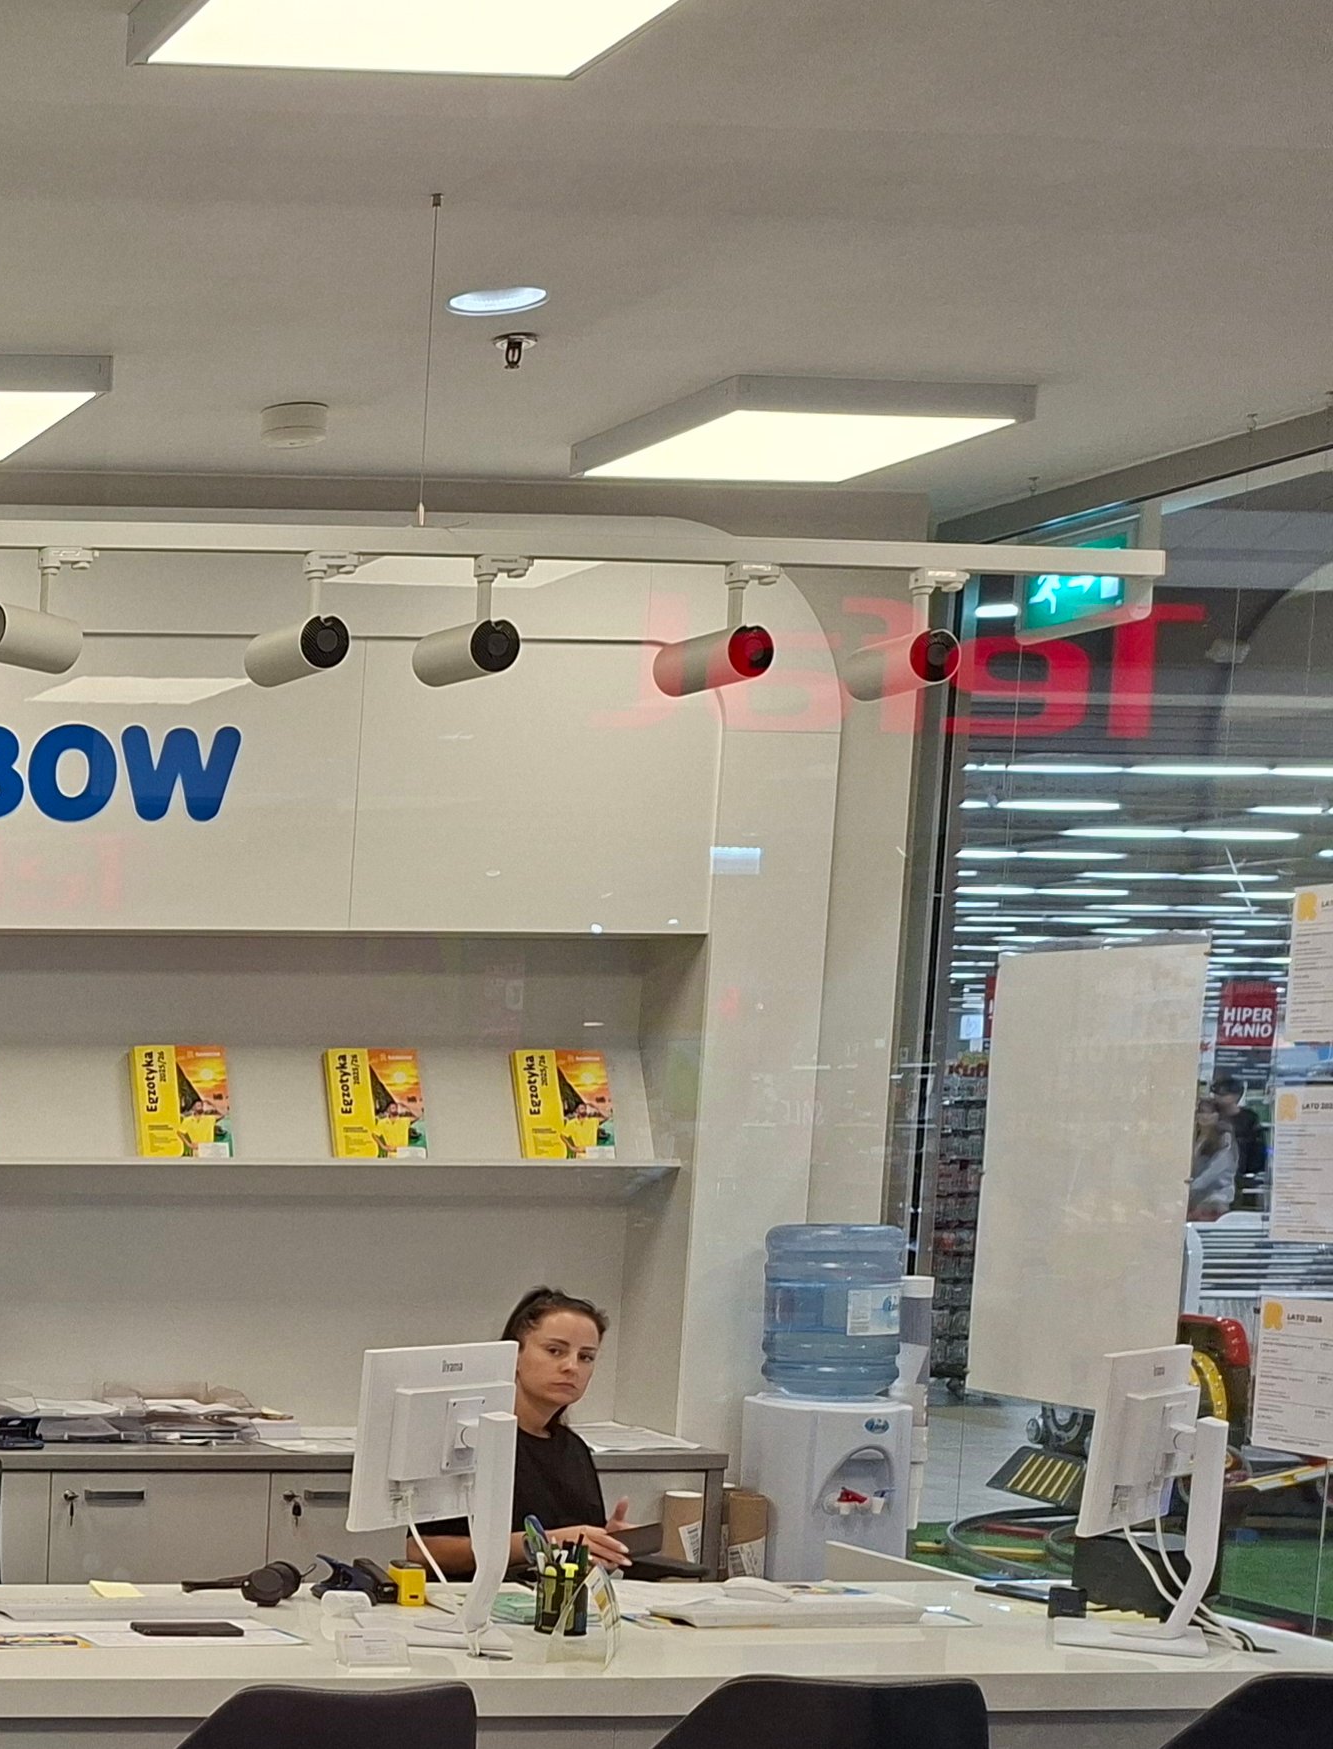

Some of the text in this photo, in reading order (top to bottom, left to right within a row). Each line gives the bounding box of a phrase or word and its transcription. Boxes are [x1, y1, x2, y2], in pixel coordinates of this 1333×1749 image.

[1222, 1023, 1273, 1038] TANIO
[1223, 1007, 1273, 1022] HIPER
[141, 1051, 159, 1113] Egzotyka
[335, 1054, 353, 1115] Egzotyka
[523, 1055, 541, 1116] Egzotyka
[1287, 1313, 1305, 1322] LATO
